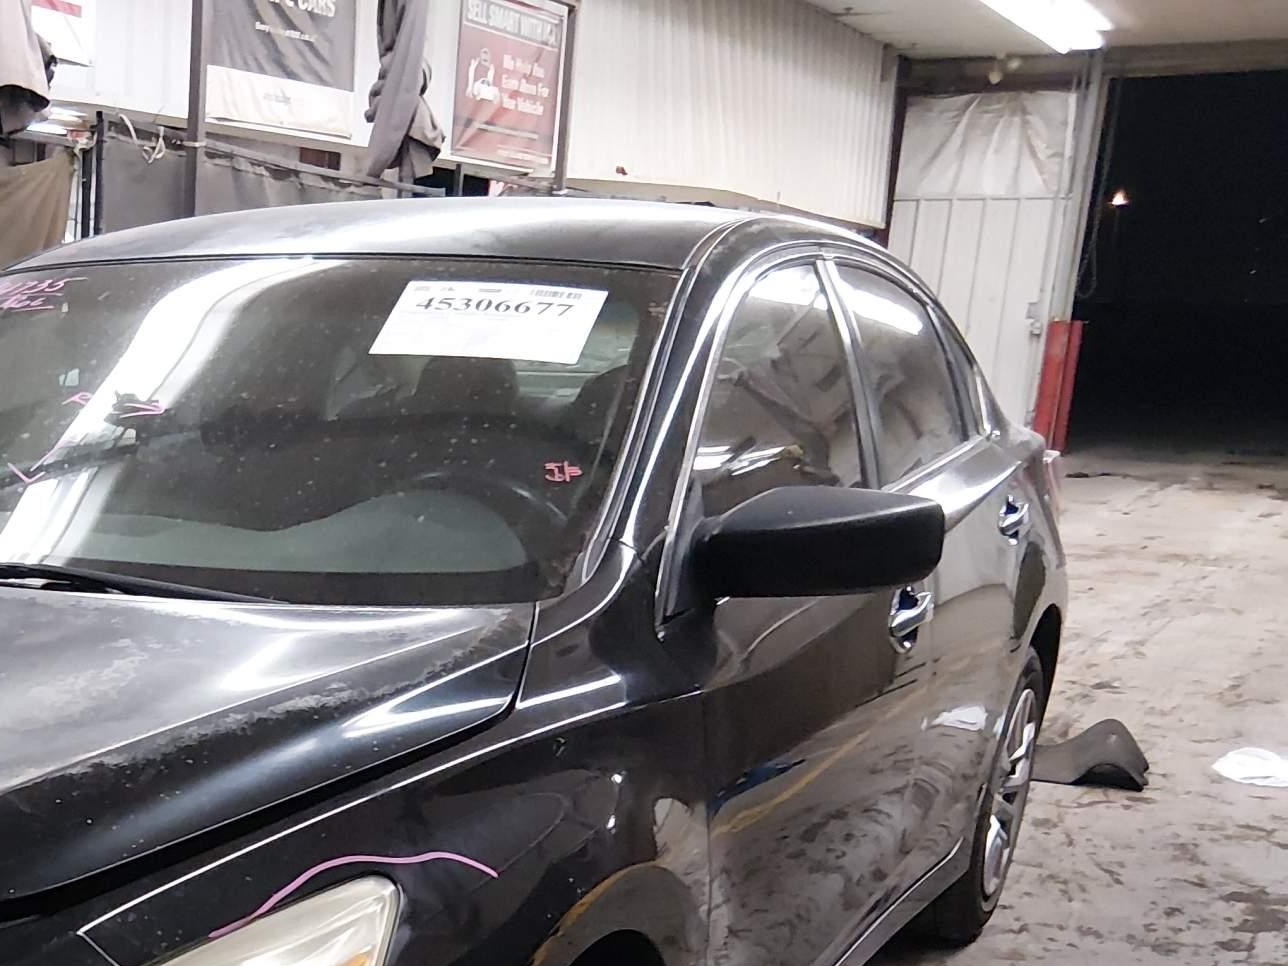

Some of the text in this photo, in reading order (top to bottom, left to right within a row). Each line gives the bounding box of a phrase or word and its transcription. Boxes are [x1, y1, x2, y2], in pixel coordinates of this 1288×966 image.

[467, 0, 489, 24] SELL
[488, 3, 521, 34] SMART
[415, 296, 575, 318] 45306677
